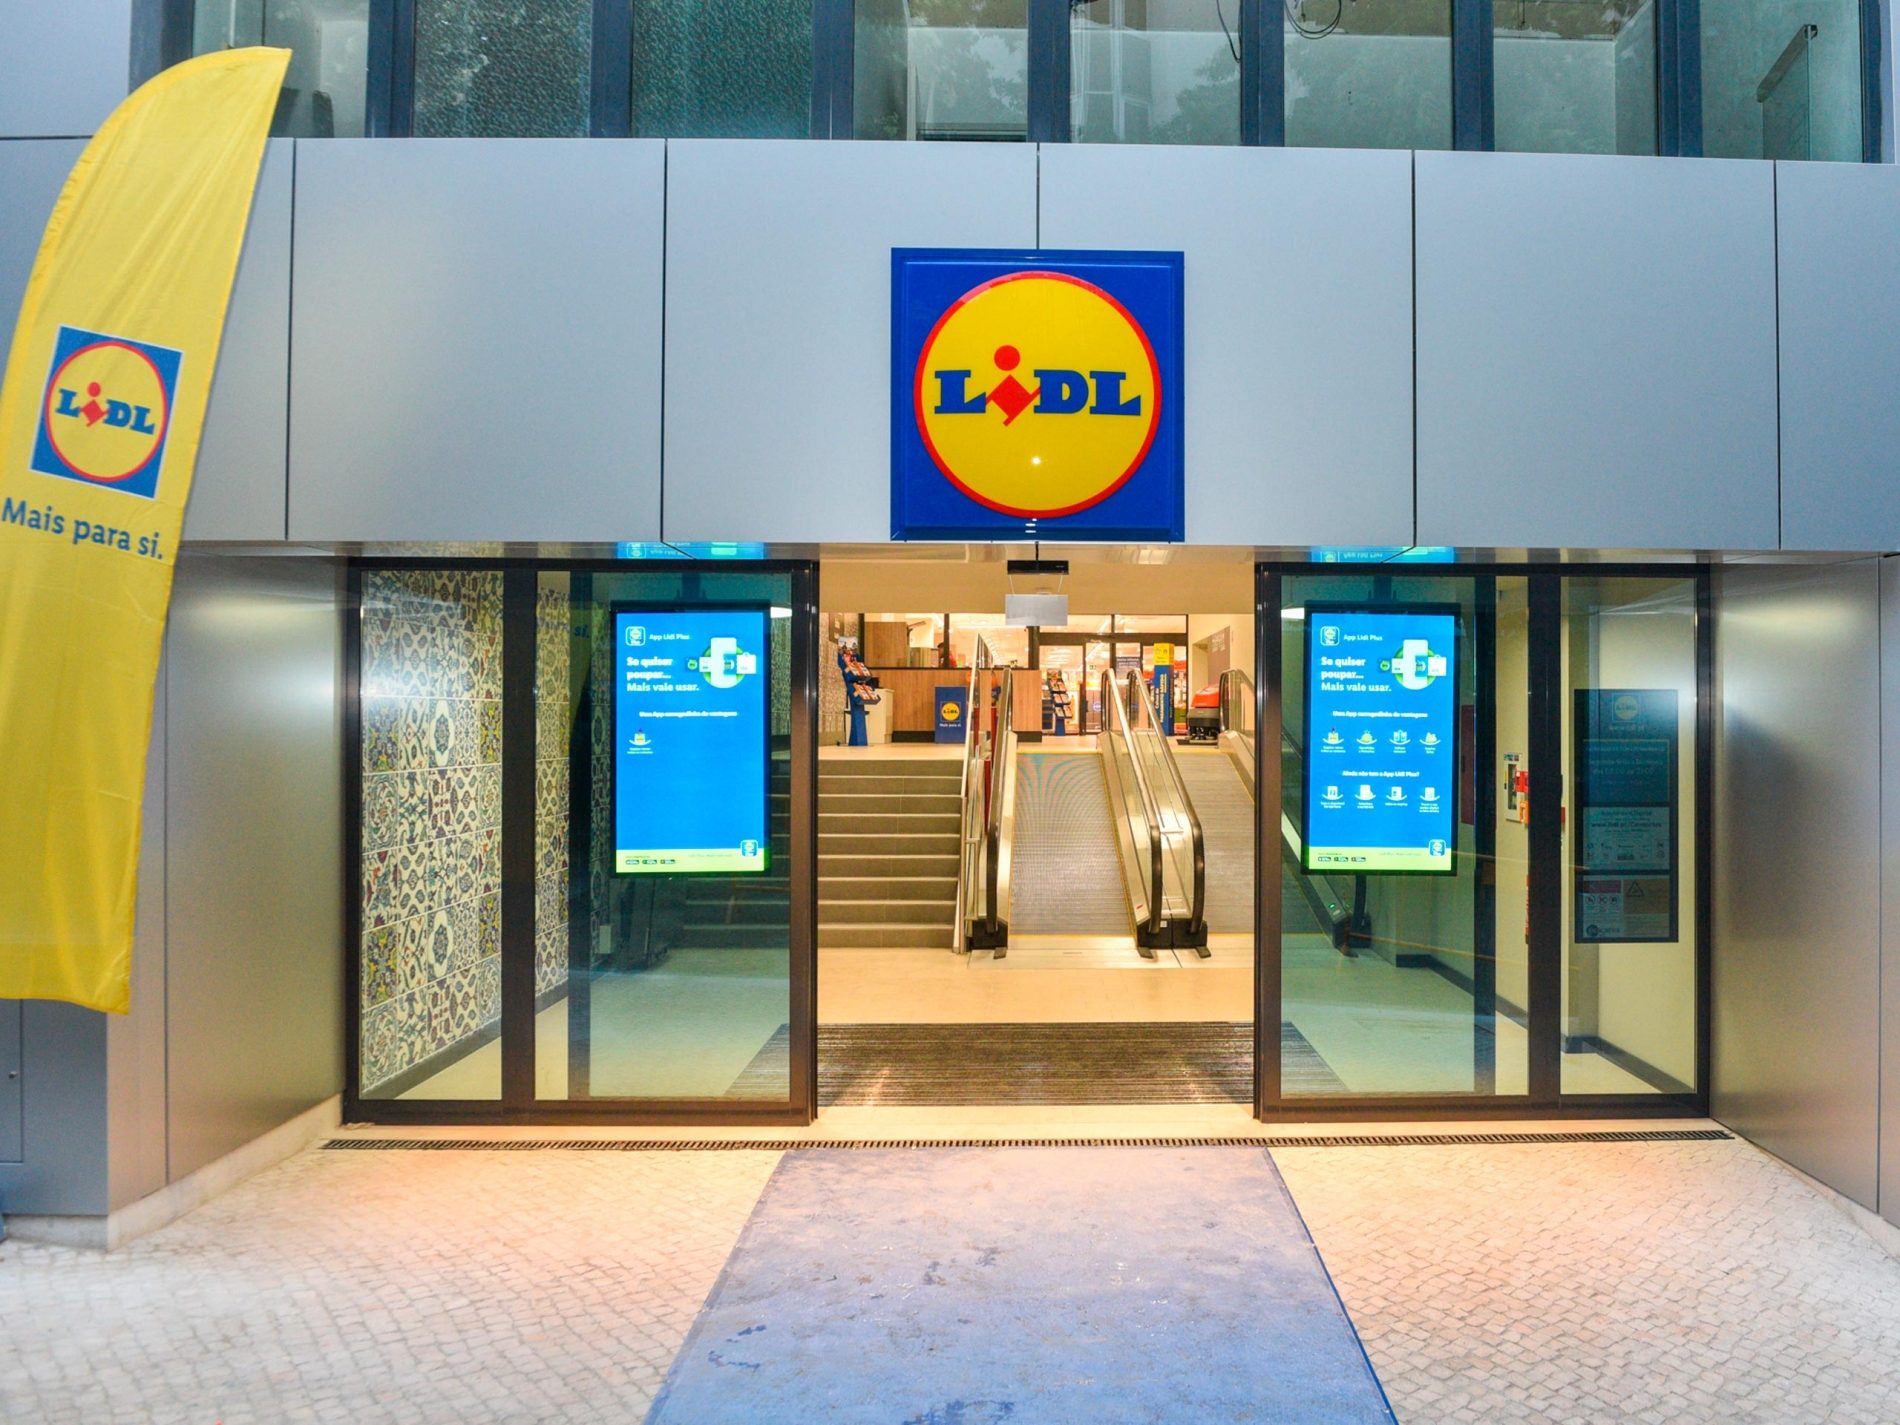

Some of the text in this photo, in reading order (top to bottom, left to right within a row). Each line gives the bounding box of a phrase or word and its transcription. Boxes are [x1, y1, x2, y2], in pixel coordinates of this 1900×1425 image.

[1, 497, 164, 560] Mais para si.
[626, 656, 673, 669] Se quiser
[1321, 656, 1366, 669] Se quiser
[626, 682, 651, 692] Mais
[653, 682, 674, 692] vale
[1321, 682, 1344, 691] Mais
[1346, 682, 1367, 692] vale
